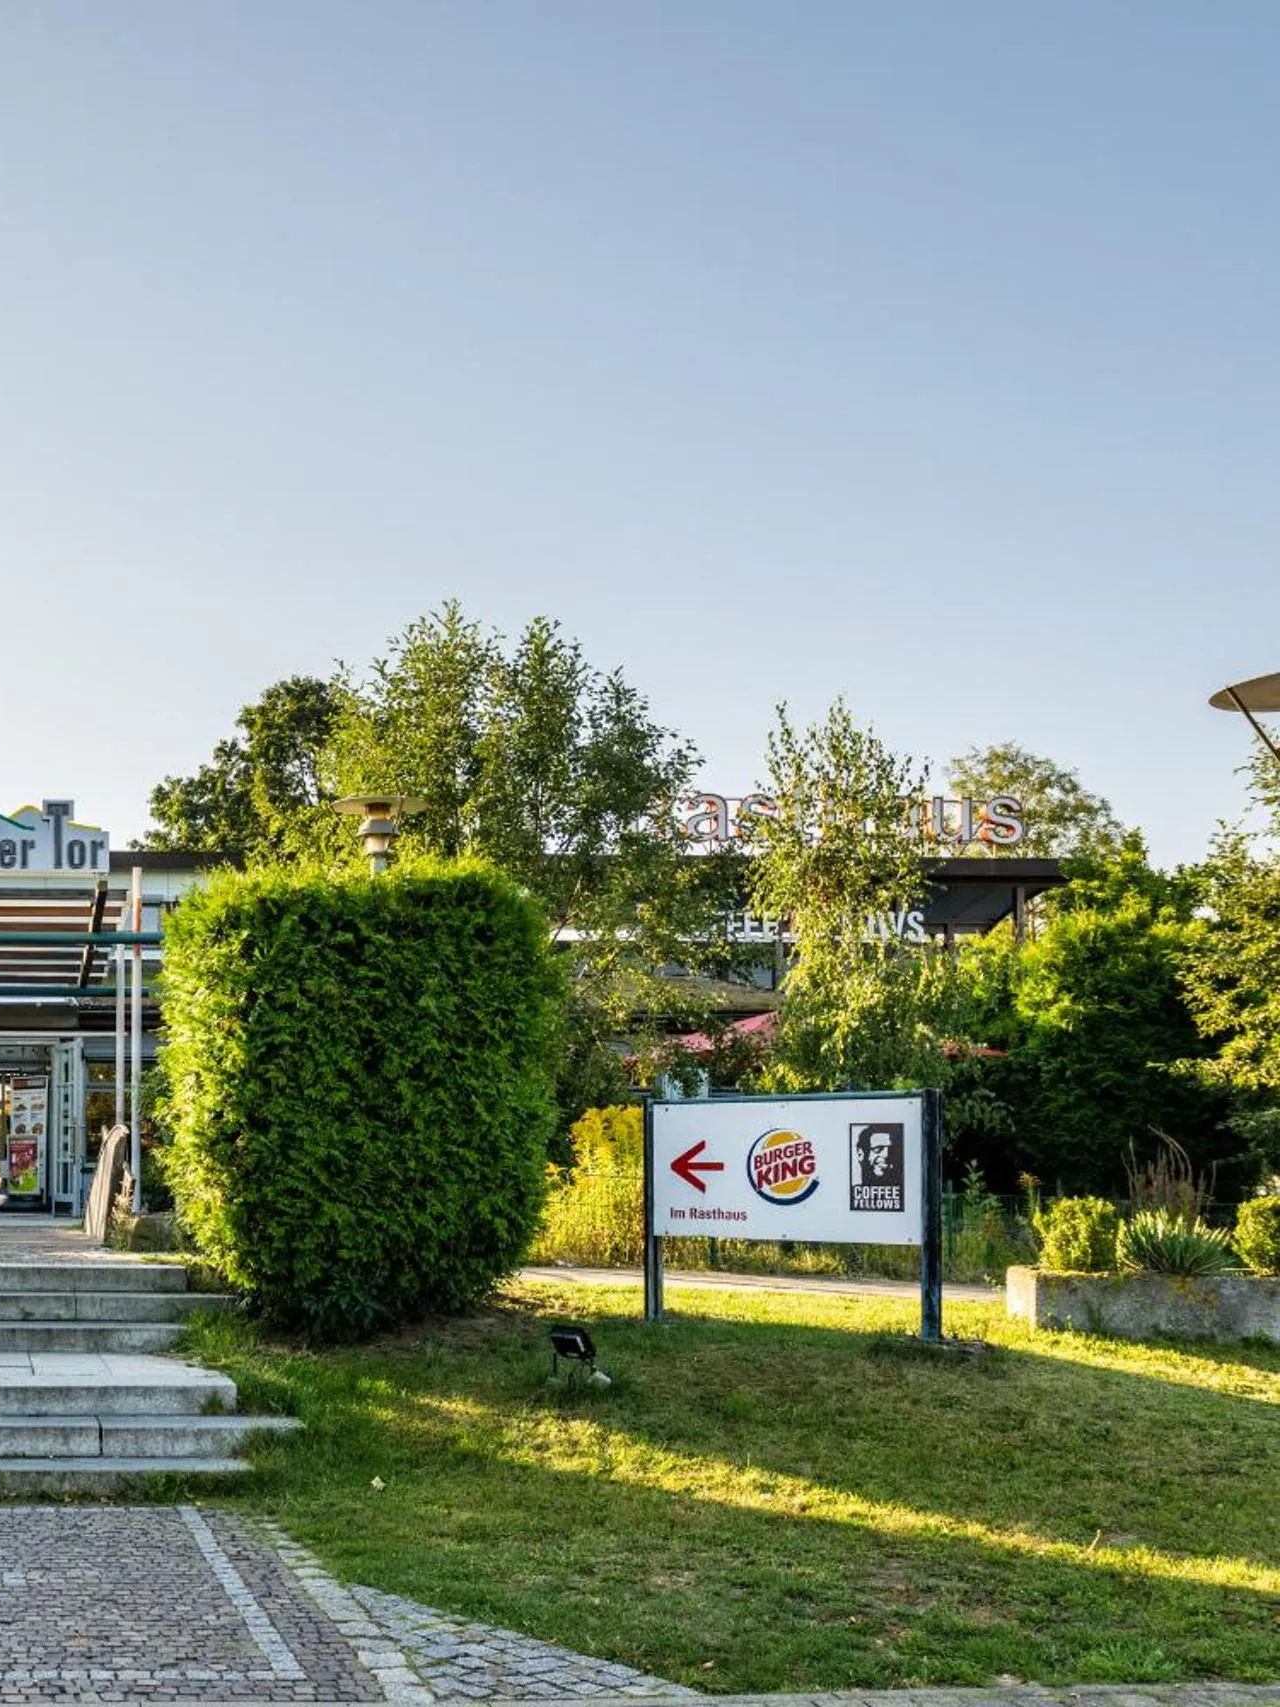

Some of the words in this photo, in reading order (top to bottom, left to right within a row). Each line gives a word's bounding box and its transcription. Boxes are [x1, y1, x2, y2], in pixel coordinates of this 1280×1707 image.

[45, 801, 105, 869] Tor
[753, 1141, 814, 1170] BURGER
[755, 1154, 816, 1190] KING
[854, 1186, 900, 1199] COFFEE
[670, 1207, 686, 1220] Im
[689, 1207, 748, 1222] Rasthaus
[854, 1199, 900, 1209] FELLOWS
